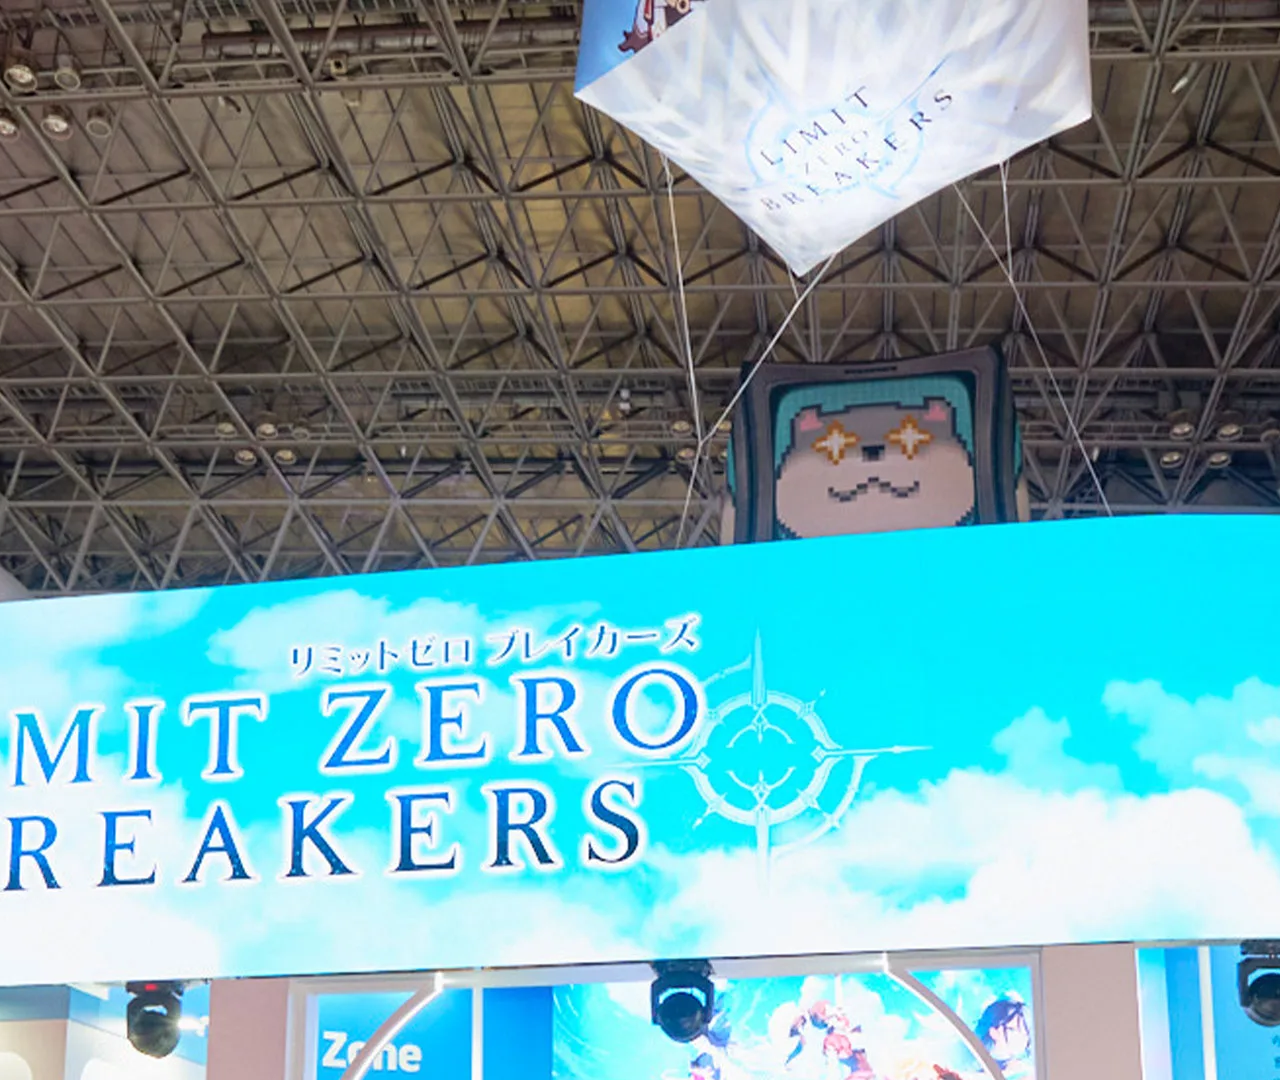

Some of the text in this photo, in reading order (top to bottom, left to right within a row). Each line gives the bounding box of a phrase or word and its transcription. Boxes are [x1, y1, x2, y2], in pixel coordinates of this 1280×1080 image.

[760, 85, 868, 166] LIMIT
[760, 89, 953, 211] BREAKERS
[292, 616, 699, 675] リミットゼロ ブレイカーズ
[323, 667, 701, 769] ZERO
